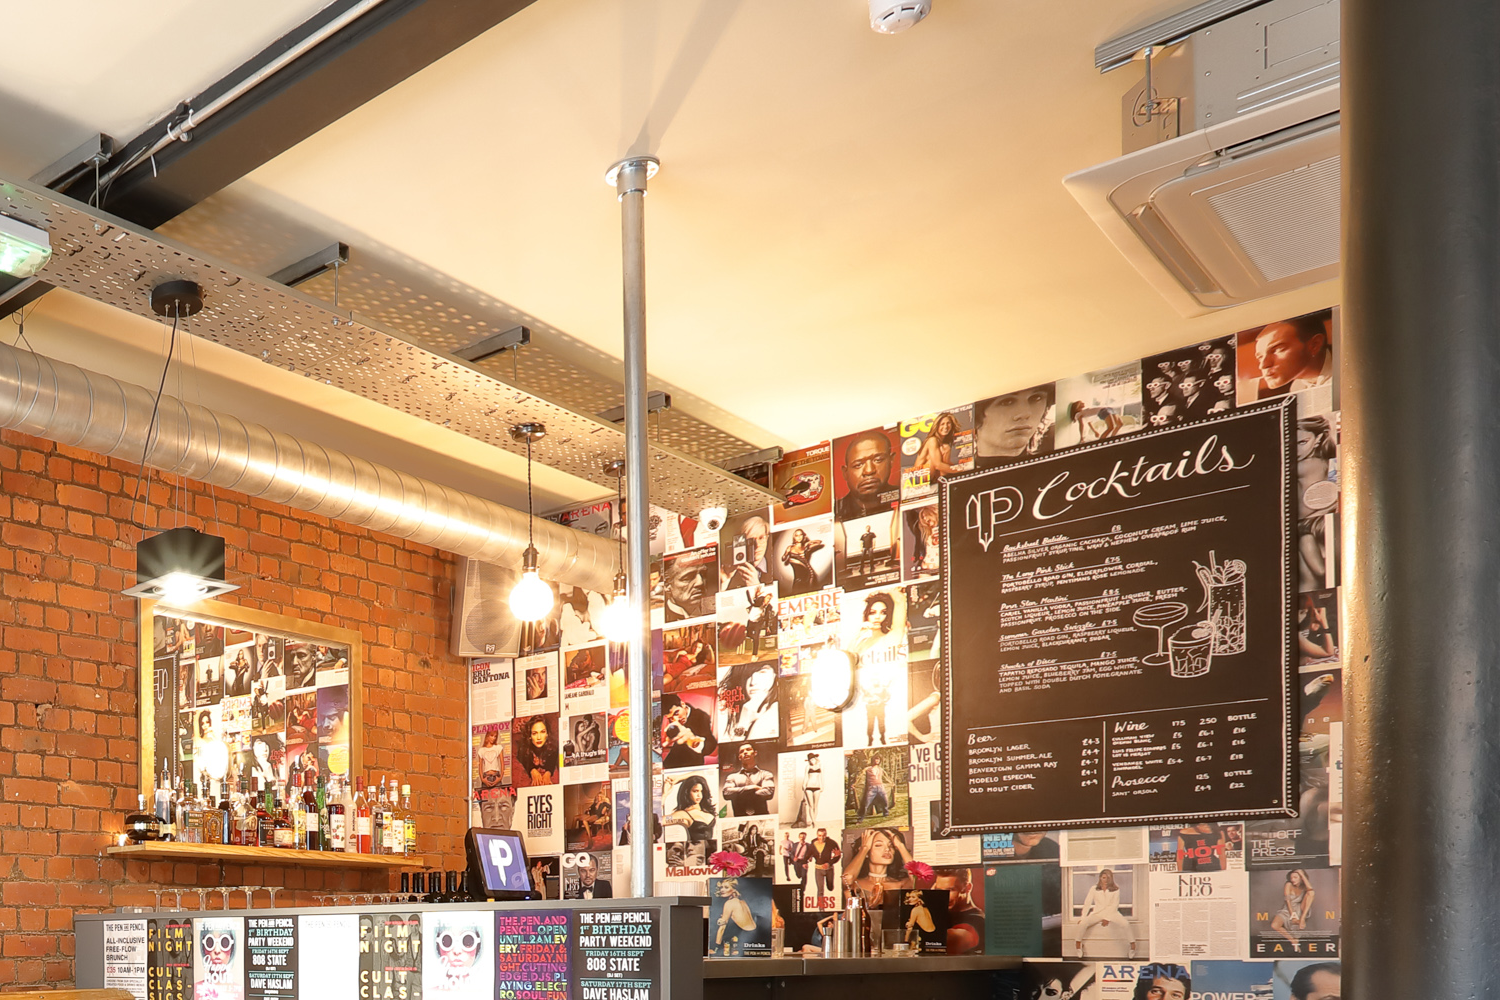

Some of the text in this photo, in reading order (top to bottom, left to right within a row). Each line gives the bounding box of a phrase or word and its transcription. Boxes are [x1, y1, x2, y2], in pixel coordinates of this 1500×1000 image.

[806, 446, 830, 457] TORQUE
[902, 468, 930, 479] BARES
[1032, 434, 1256, 520] Cocktails
[562, 502, 612, 521] ARENA
[1114, 520, 1199, 541] COCONUT LIME
[1054, 562, 1074, 571] Stick
[1109, 567, 1146, 578] LEMONADE
[1002, 578, 1042, 589] PORTOBELLO
[778, 591, 842, 616] EMPIRE
[472, 662, 491, 671] ICON
[1090, 659, 1116, 667] MANGO
[472, 672, 510, 685] CANTONA
[473, 669, 491, 677] ERIC
[472, 722, 510, 734] PLAYBOY
[1114, 720, 1149, 733] Wine
[1199, 717, 1218, 725] 250
[1227, 712, 1257, 722] BOTTLE
[1233, 727, 1247, 735] £16
[967, 733, 997, 746] Beer
[908, 744, 930, 763] I've
[969, 743, 1031, 756] BROOKLYN LAGER
[969, 756, 1003, 765] BROOKLYN
[1006, 753, 1038, 762] SUMMER
[908, 762, 941, 782] Chills
[969, 761, 1058, 775] BEAVERTOWN GAMMA RAY
[969, 773, 1037, 785] MODELO ESPECIAL
[1111, 769, 1253, 789] Prosecco BOTTLE
[1011, 783, 1035, 791] CIDER
[1229, 782, 1245, 790] £22
[473, 786, 517, 801] ARENA
[527, 794, 553, 814] EYES
[527, 813, 553, 830] RIGHT
[983, 833, 1014, 842] NEW
[1276, 829, 1301, 839] OFF
[983, 841, 1014, 849] COOL
[1251, 839, 1275, 848] THE
[1177, 844, 1225, 861] HOT
[1252, 846, 1296, 857] PRESS
[562, 852, 592, 868] GQ
[665, 865, 718, 877] Malkovic
[1157, 862, 1177, 872] TYLER
[1178, 875, 1212, 887] King
[1178, 885, 1212, 897] LEO
[805, 896, 836, 908] CLASS
[248, 919, 294, 928] THE PENCIL
[580, 912, 652, 923] THE PEN PENCIL
[148, 928, 183, 938] FILM
[256, 929, 293, 937] BIRTHDAY
[360, 925, 408, 938] FILM
[592, 924, 651, 934] BIRTHDAY
[148, 941, 192, 952] NIGHT
[248, 937, 294, 946] PARTY WEEKEND
[360, 940, 421, 953] NIGHT
[580, 935, 652, 947] PARTY WEEKEND
[252, 955, 287, 965] 808 STATE
[586, 958, 640, 972] 808 STATE
[148, 967, 182, 977] CULT
[360, 971, 407, 984] CULT
[1102, 965, 1190, 979] ARENA
[251, 979, 293, 989] DAVE HASLAM
[583, 988, 649, 1000] DAVE HASLAM
